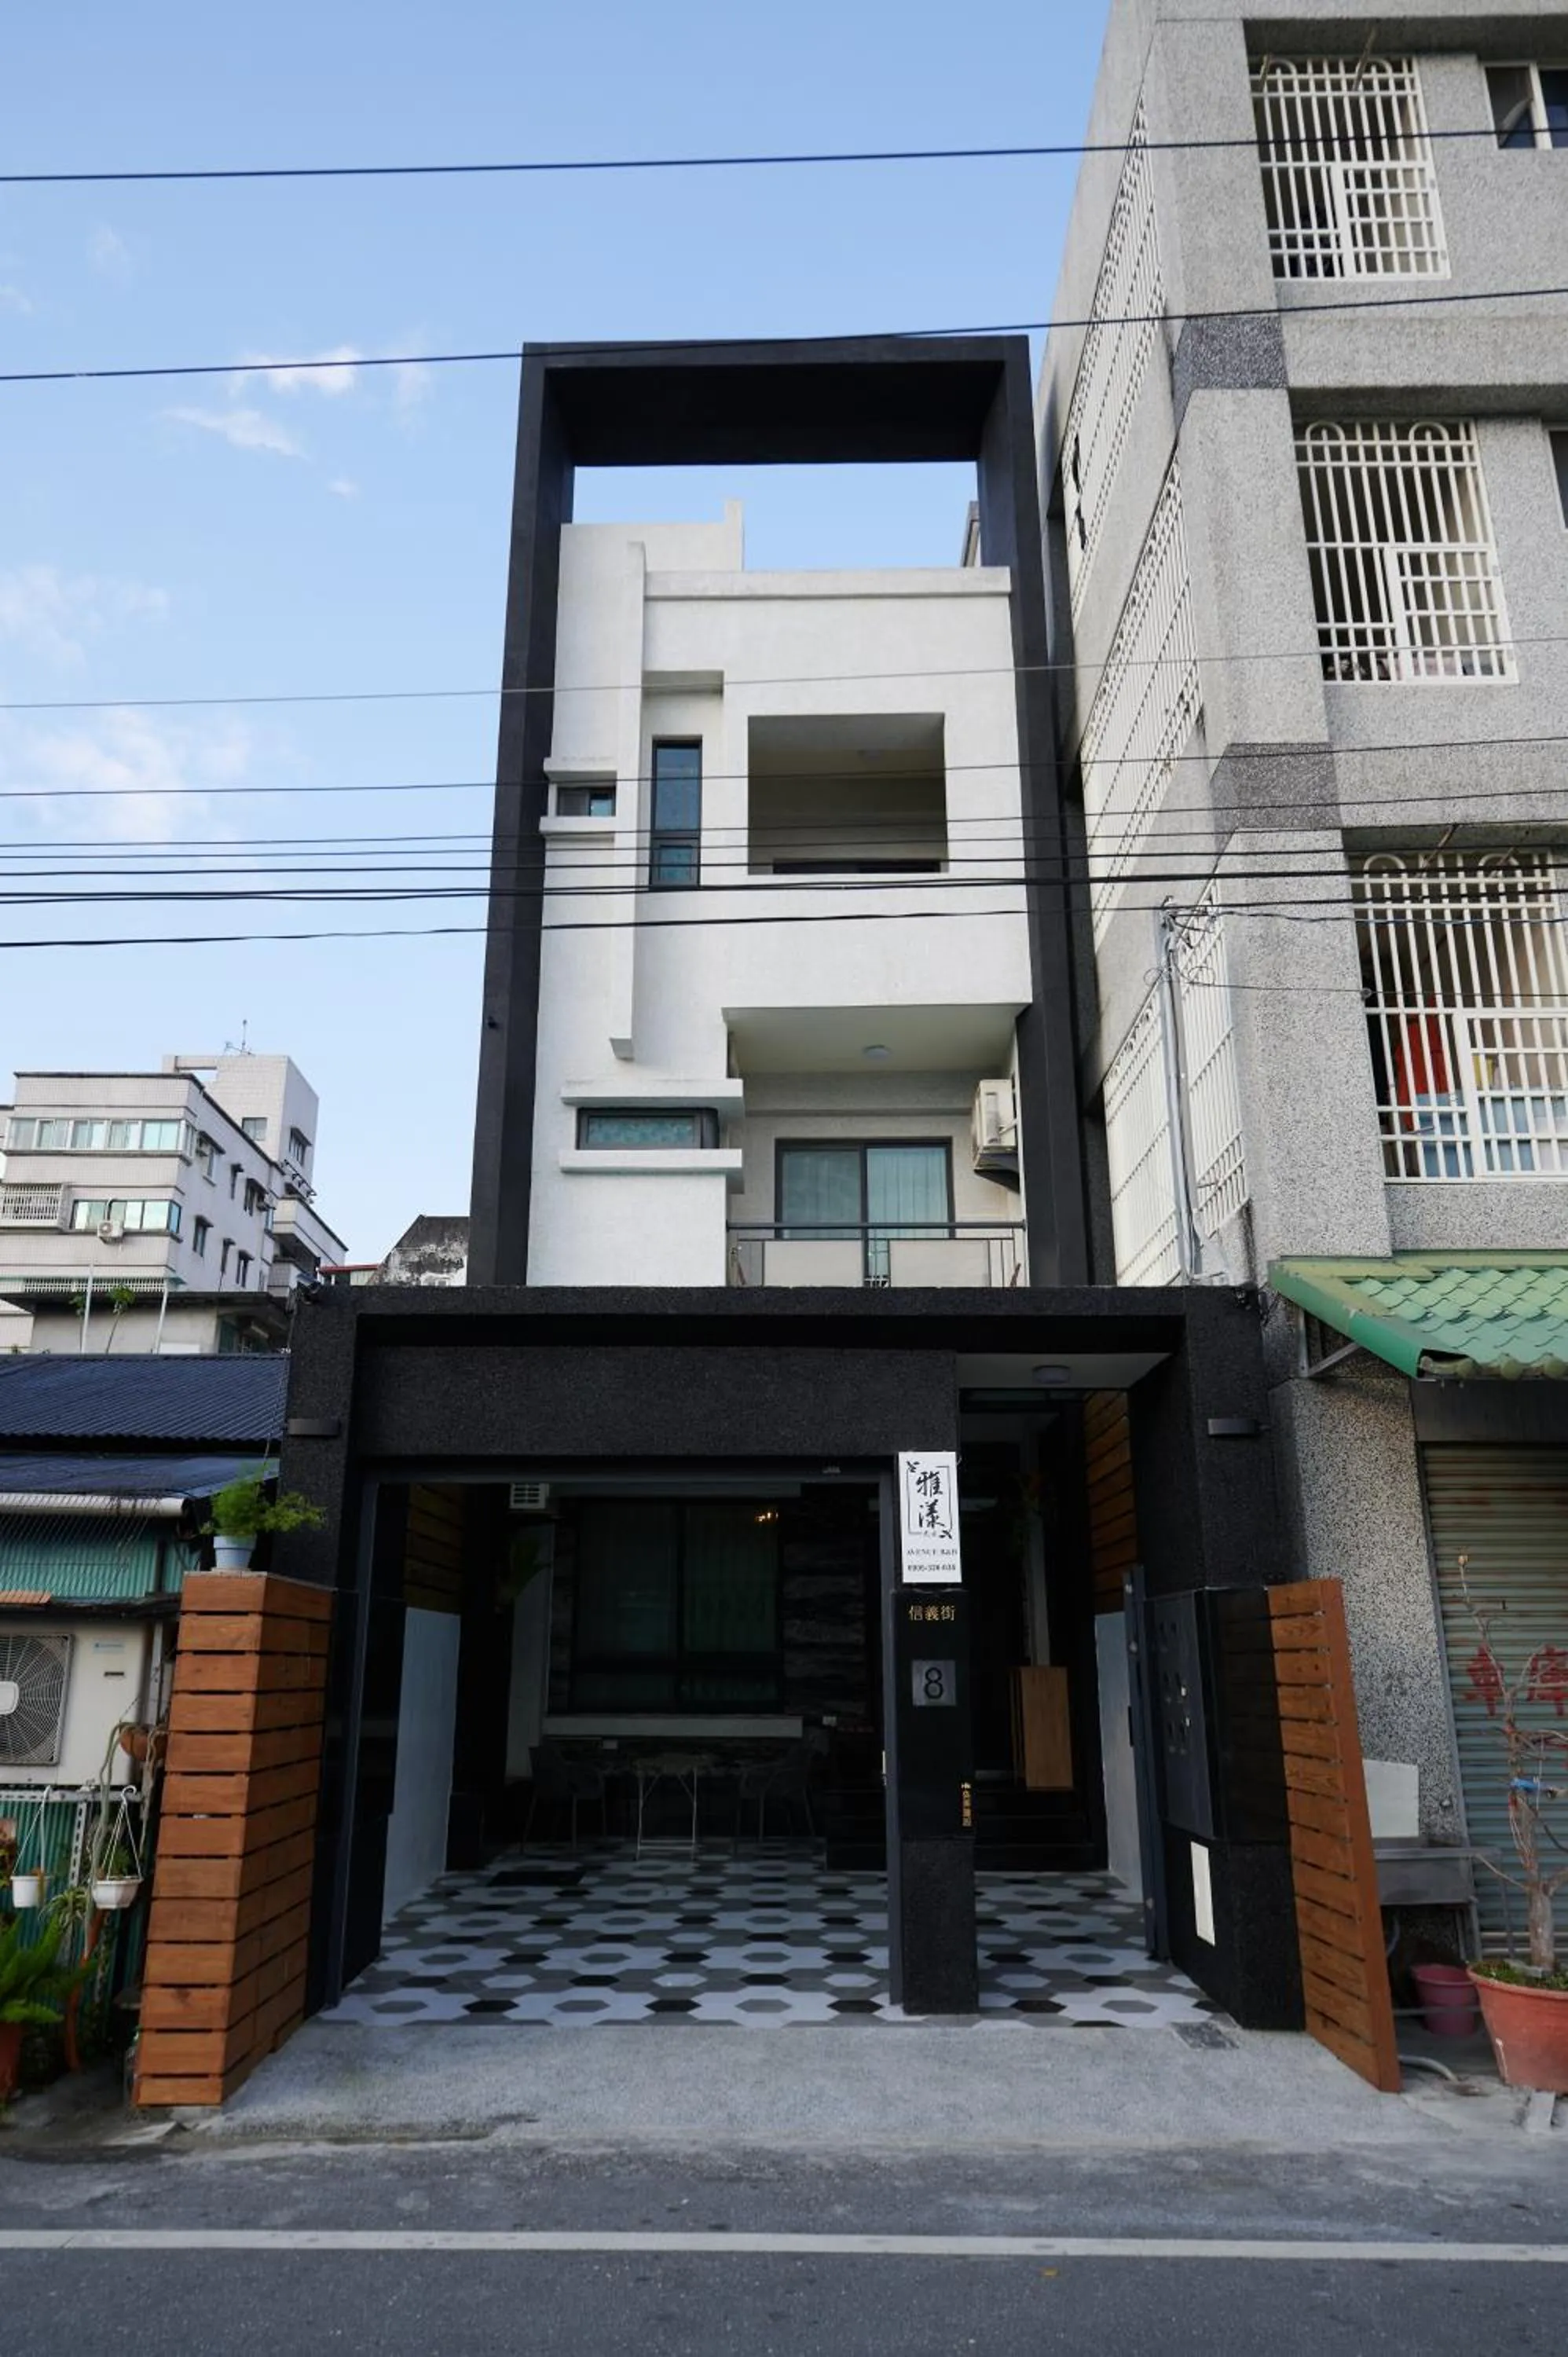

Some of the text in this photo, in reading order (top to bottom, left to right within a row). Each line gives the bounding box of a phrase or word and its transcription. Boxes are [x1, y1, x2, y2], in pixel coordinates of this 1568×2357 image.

[909, 1604, 955, 1621] 信義街
[924, 1666, 943, 1699] 8
